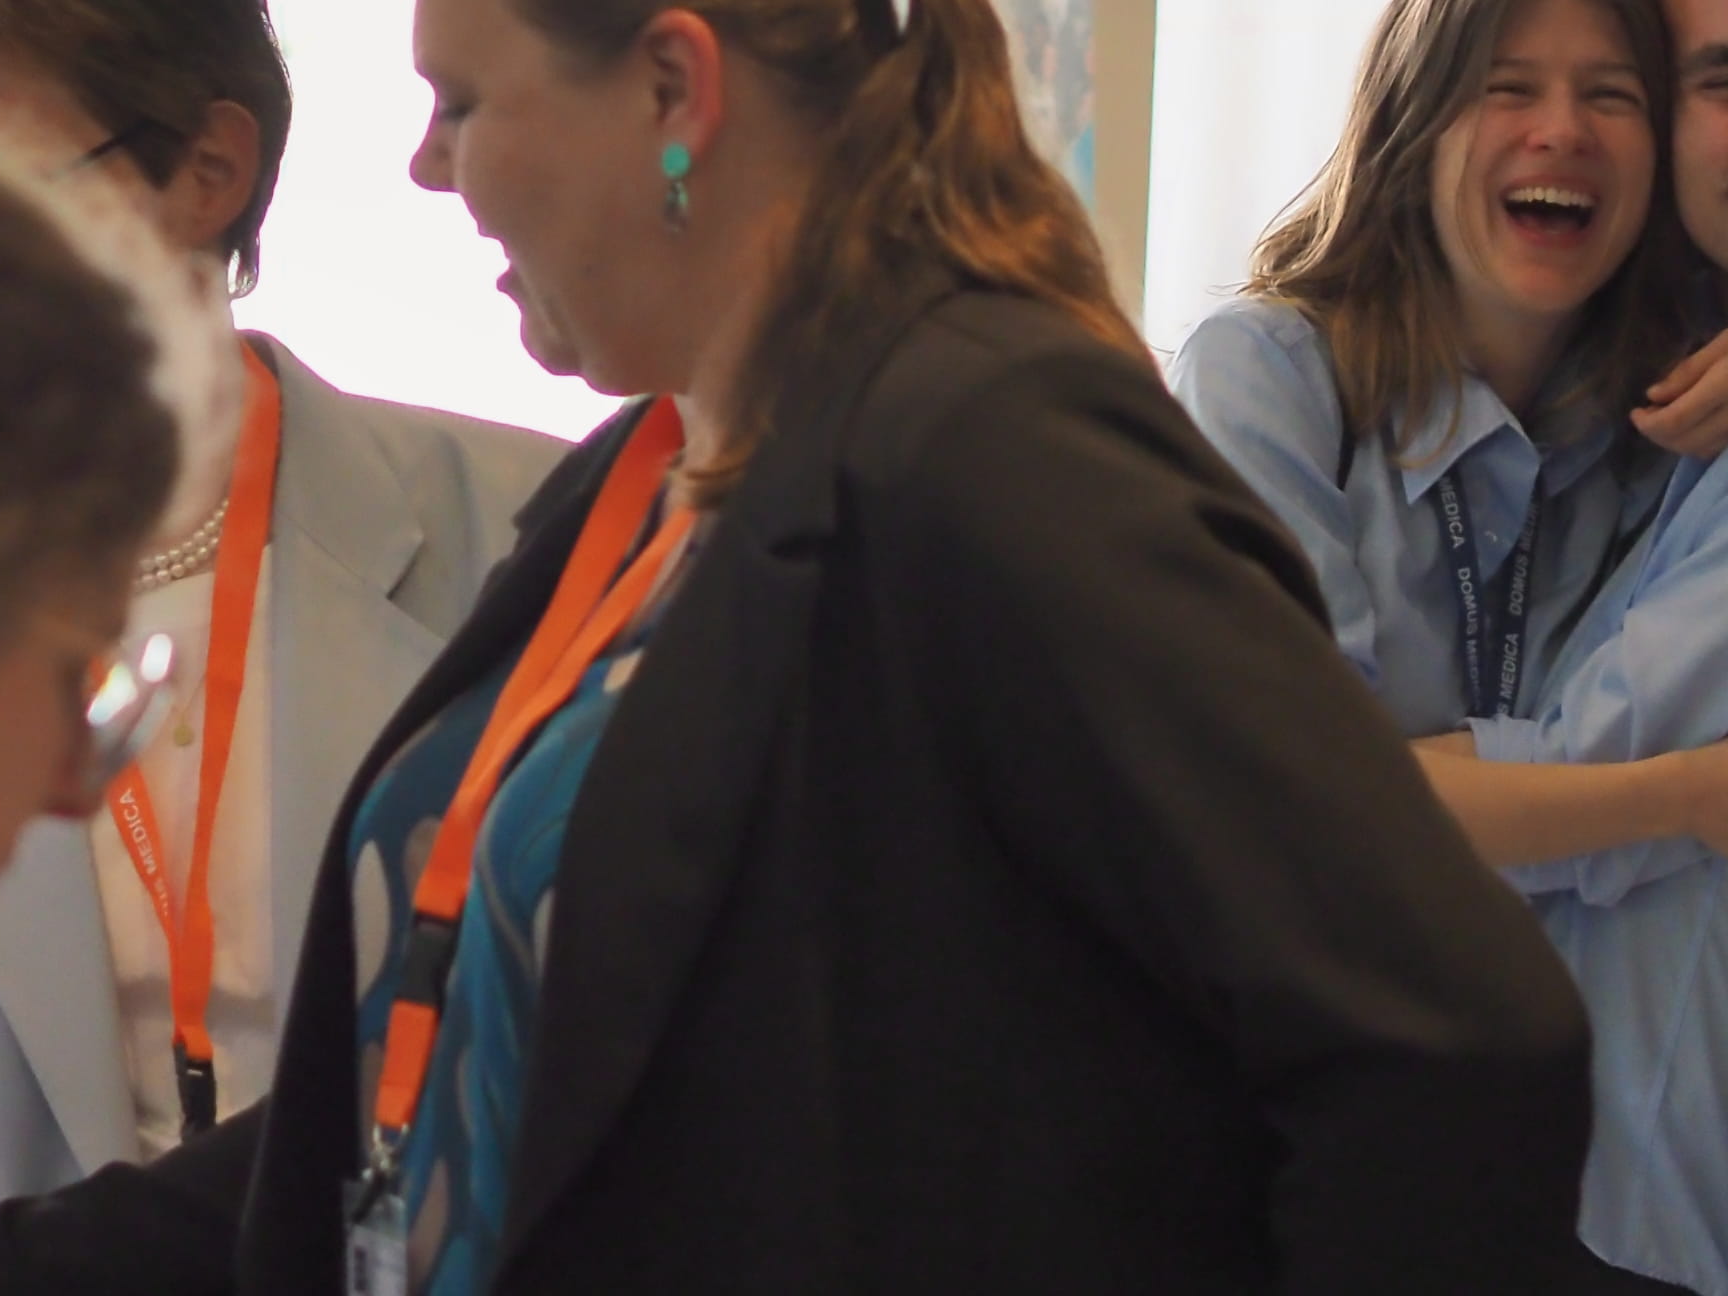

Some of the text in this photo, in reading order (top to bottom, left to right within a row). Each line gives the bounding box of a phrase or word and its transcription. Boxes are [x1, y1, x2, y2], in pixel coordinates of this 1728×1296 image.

[1439, 476, 1465, 549] MEDICA
[1457, 567, 1479, 636] DOMUS
[1508, 554, 1529, 616] DOMUS
[1499, 633, 1519, 699] MEDICA
[119, 788, 158, 875] MEDICA
